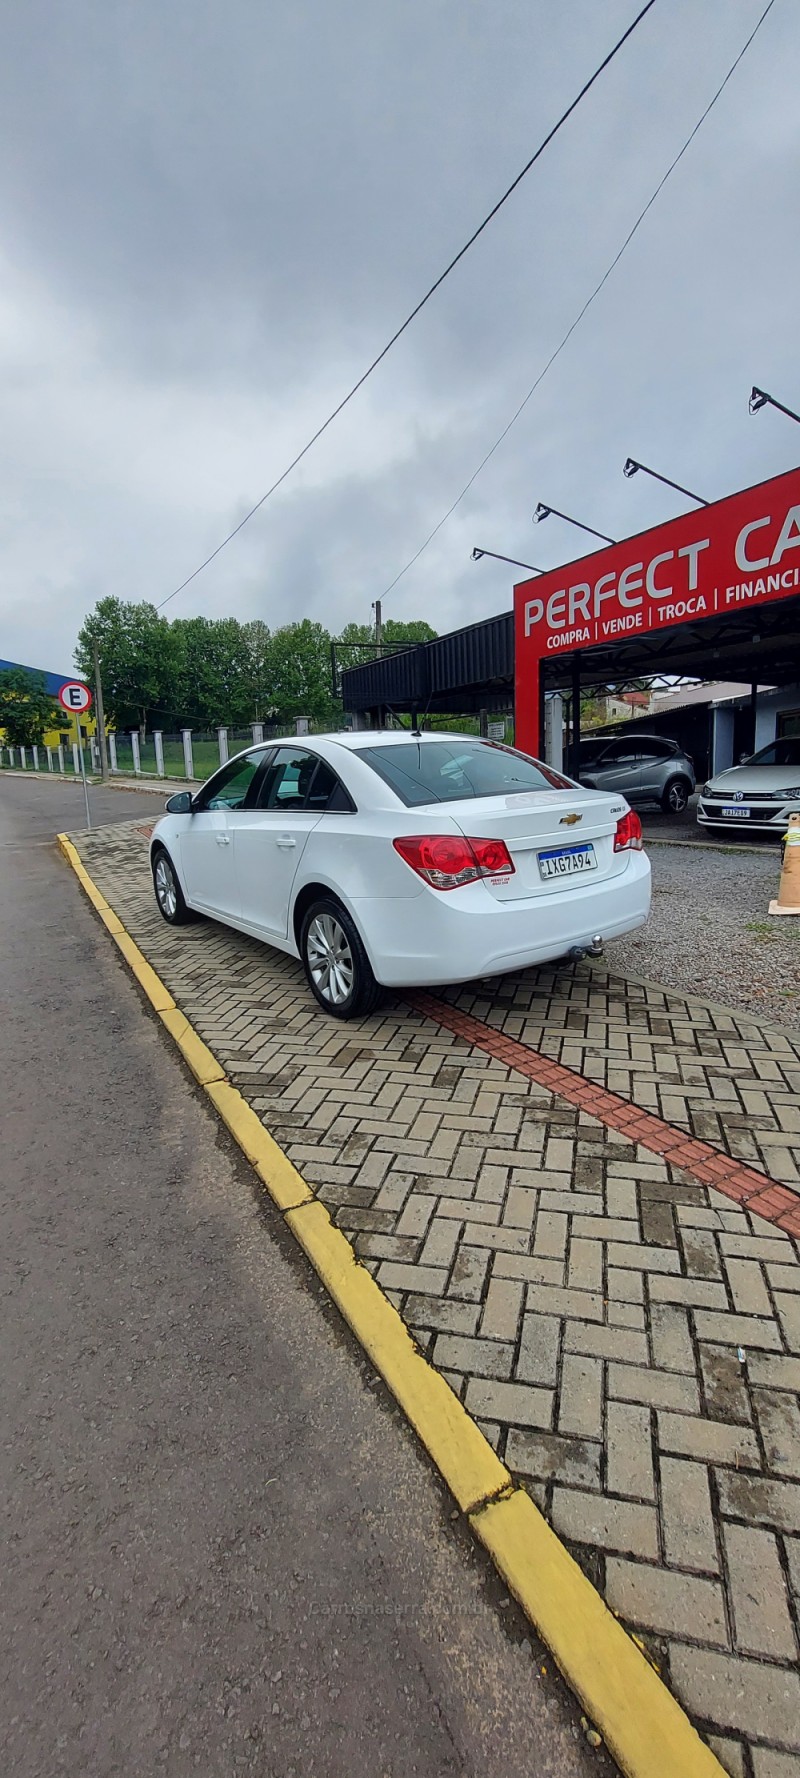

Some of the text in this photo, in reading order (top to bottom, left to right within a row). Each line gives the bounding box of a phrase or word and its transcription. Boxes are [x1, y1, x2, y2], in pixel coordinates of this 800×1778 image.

[524, 538, 710, 637] PERFECT
[546, 626, 591, 649] COMPRA
[602, 612, 643, 635] VENDE
[657, 595, 707, 622] TROCA
[68, 688, 82, 706] E
[546, 853, 591, 875] IXG7A94
